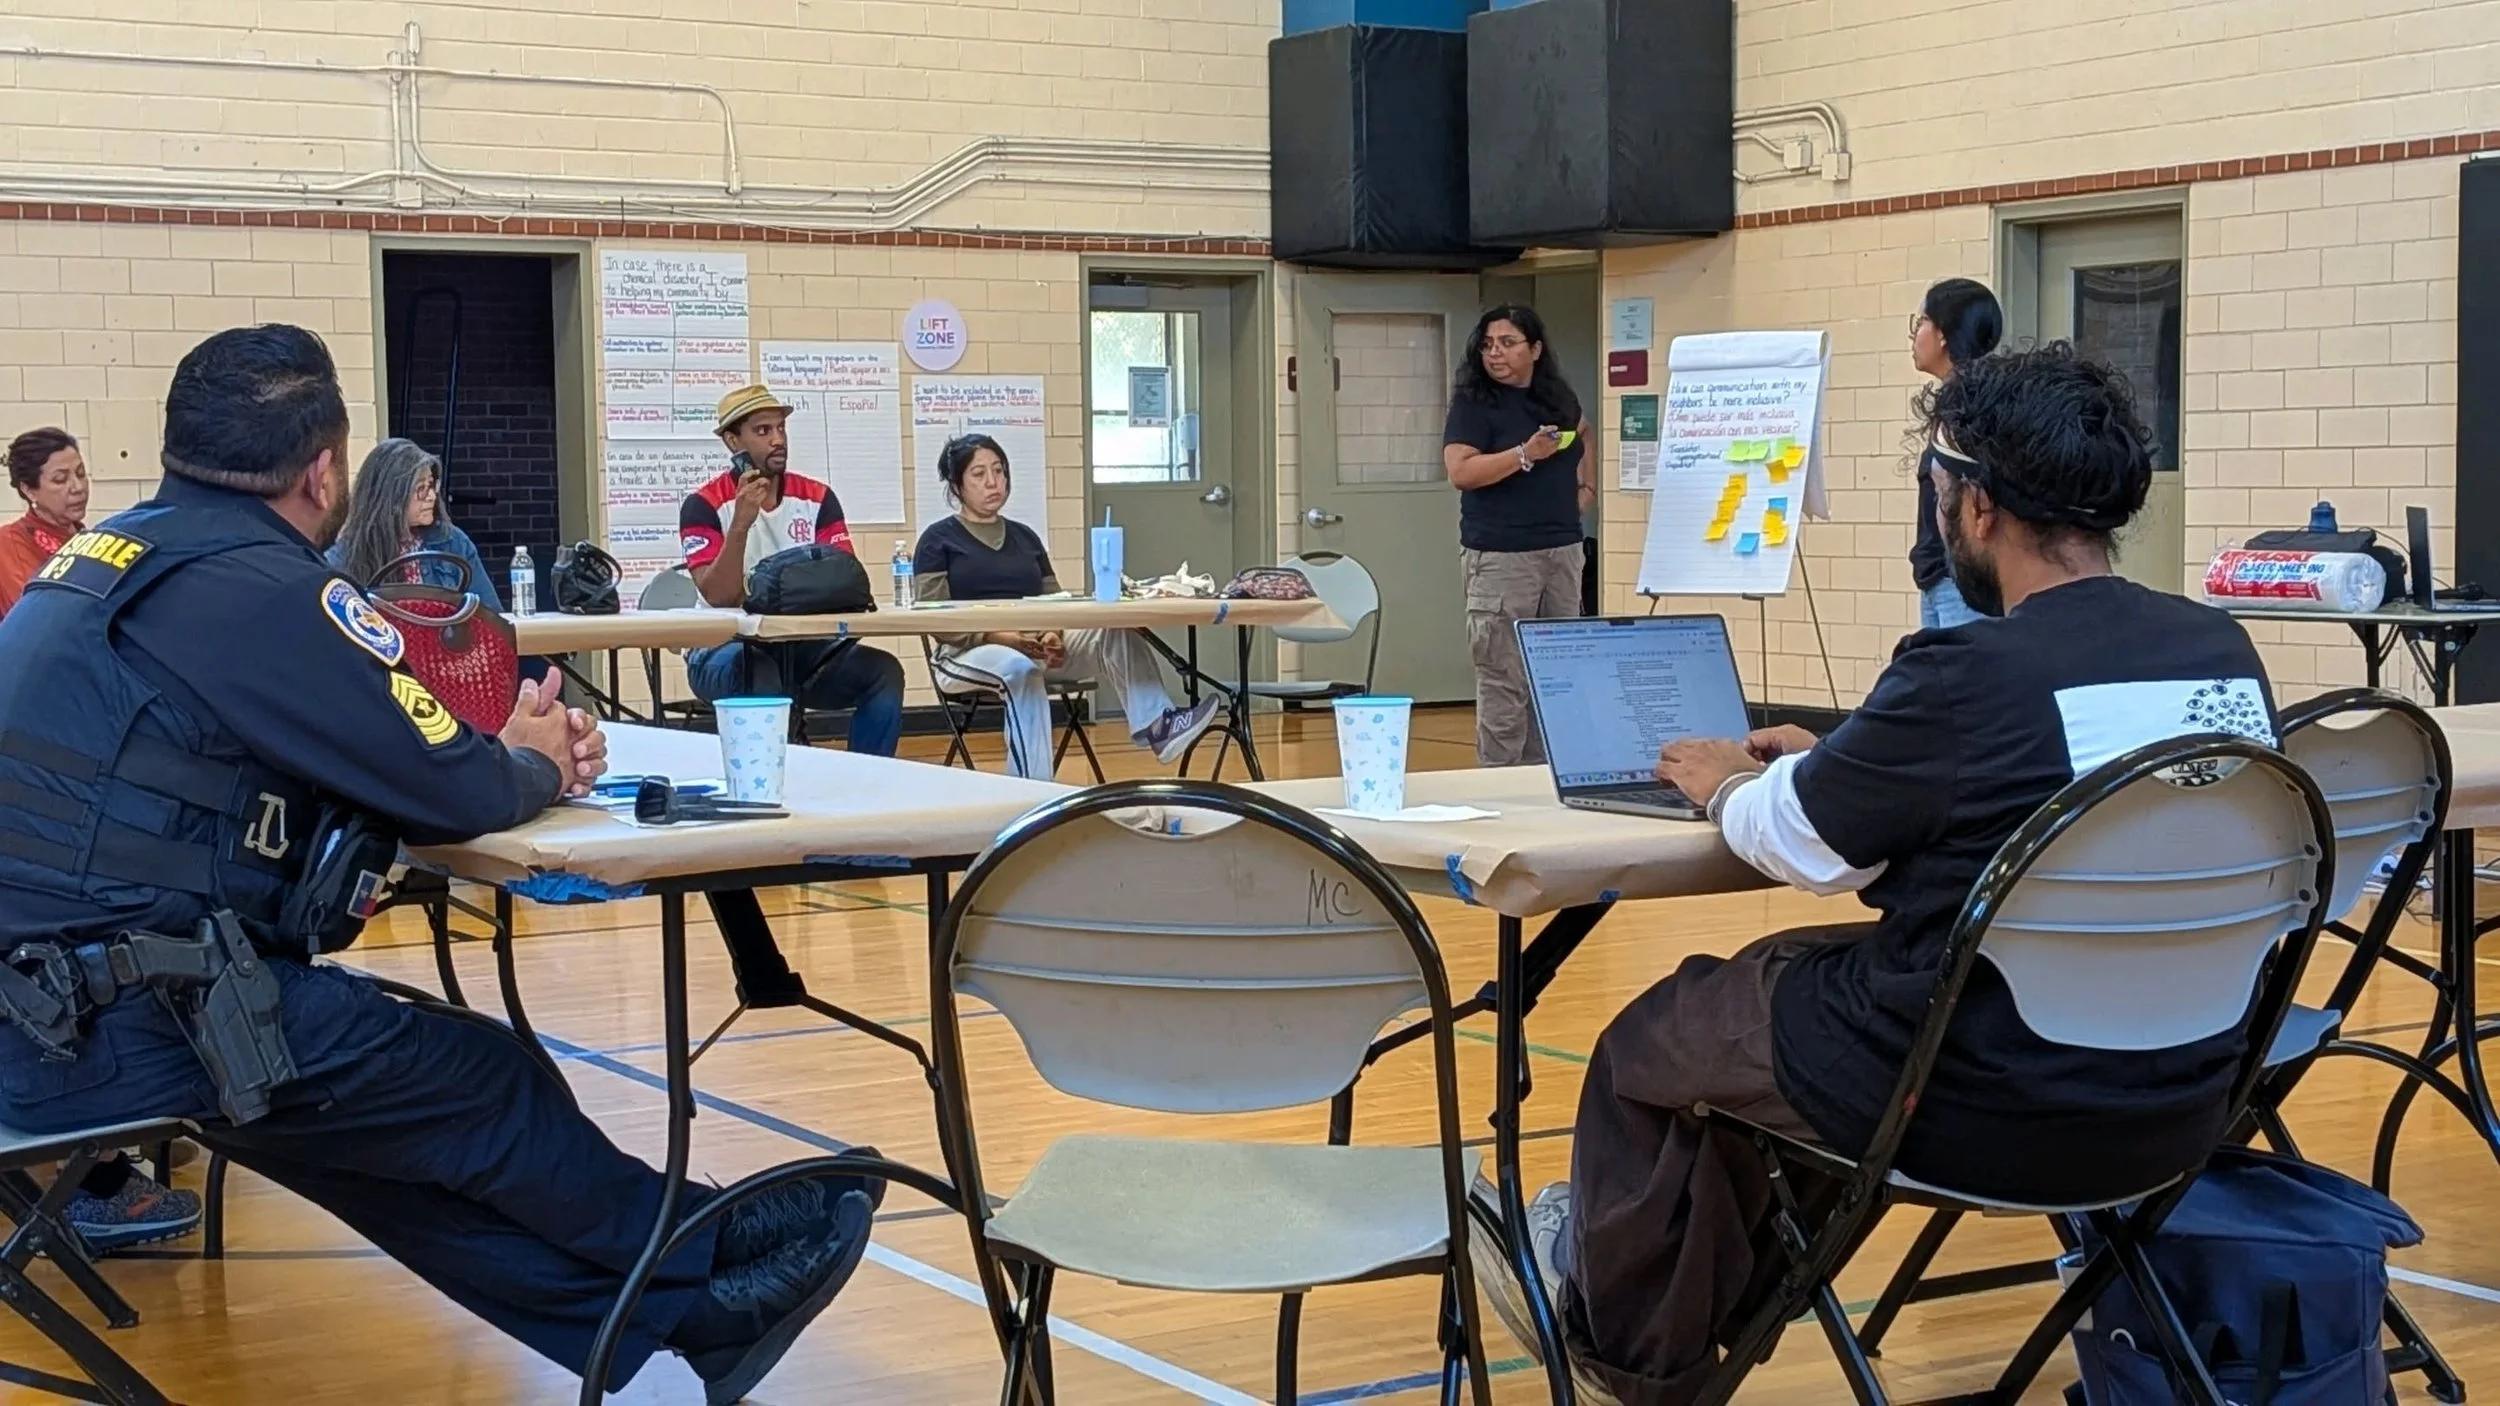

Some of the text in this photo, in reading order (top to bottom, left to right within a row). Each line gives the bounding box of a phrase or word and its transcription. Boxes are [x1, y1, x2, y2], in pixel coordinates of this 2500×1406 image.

[604, 256, 619, 271] In
[623, 260, 649, 271] case
[652, 258, 682, 271] there
[686, 262, 696, 271] is
[604, 282, 617, 296] to
[920, 318, 949, 330] LIFT
[916, 332, 956, 344] ZONE
[1691, 384, 1704, 394] can
[1793, 381, 1808, 394] my
[839, 393, 879, 416] Español
[2238, 562, 2277, 573] PLASTIC
[1172, 711, 1193, 733] N
[1307, 867, 1364, 928] MC
